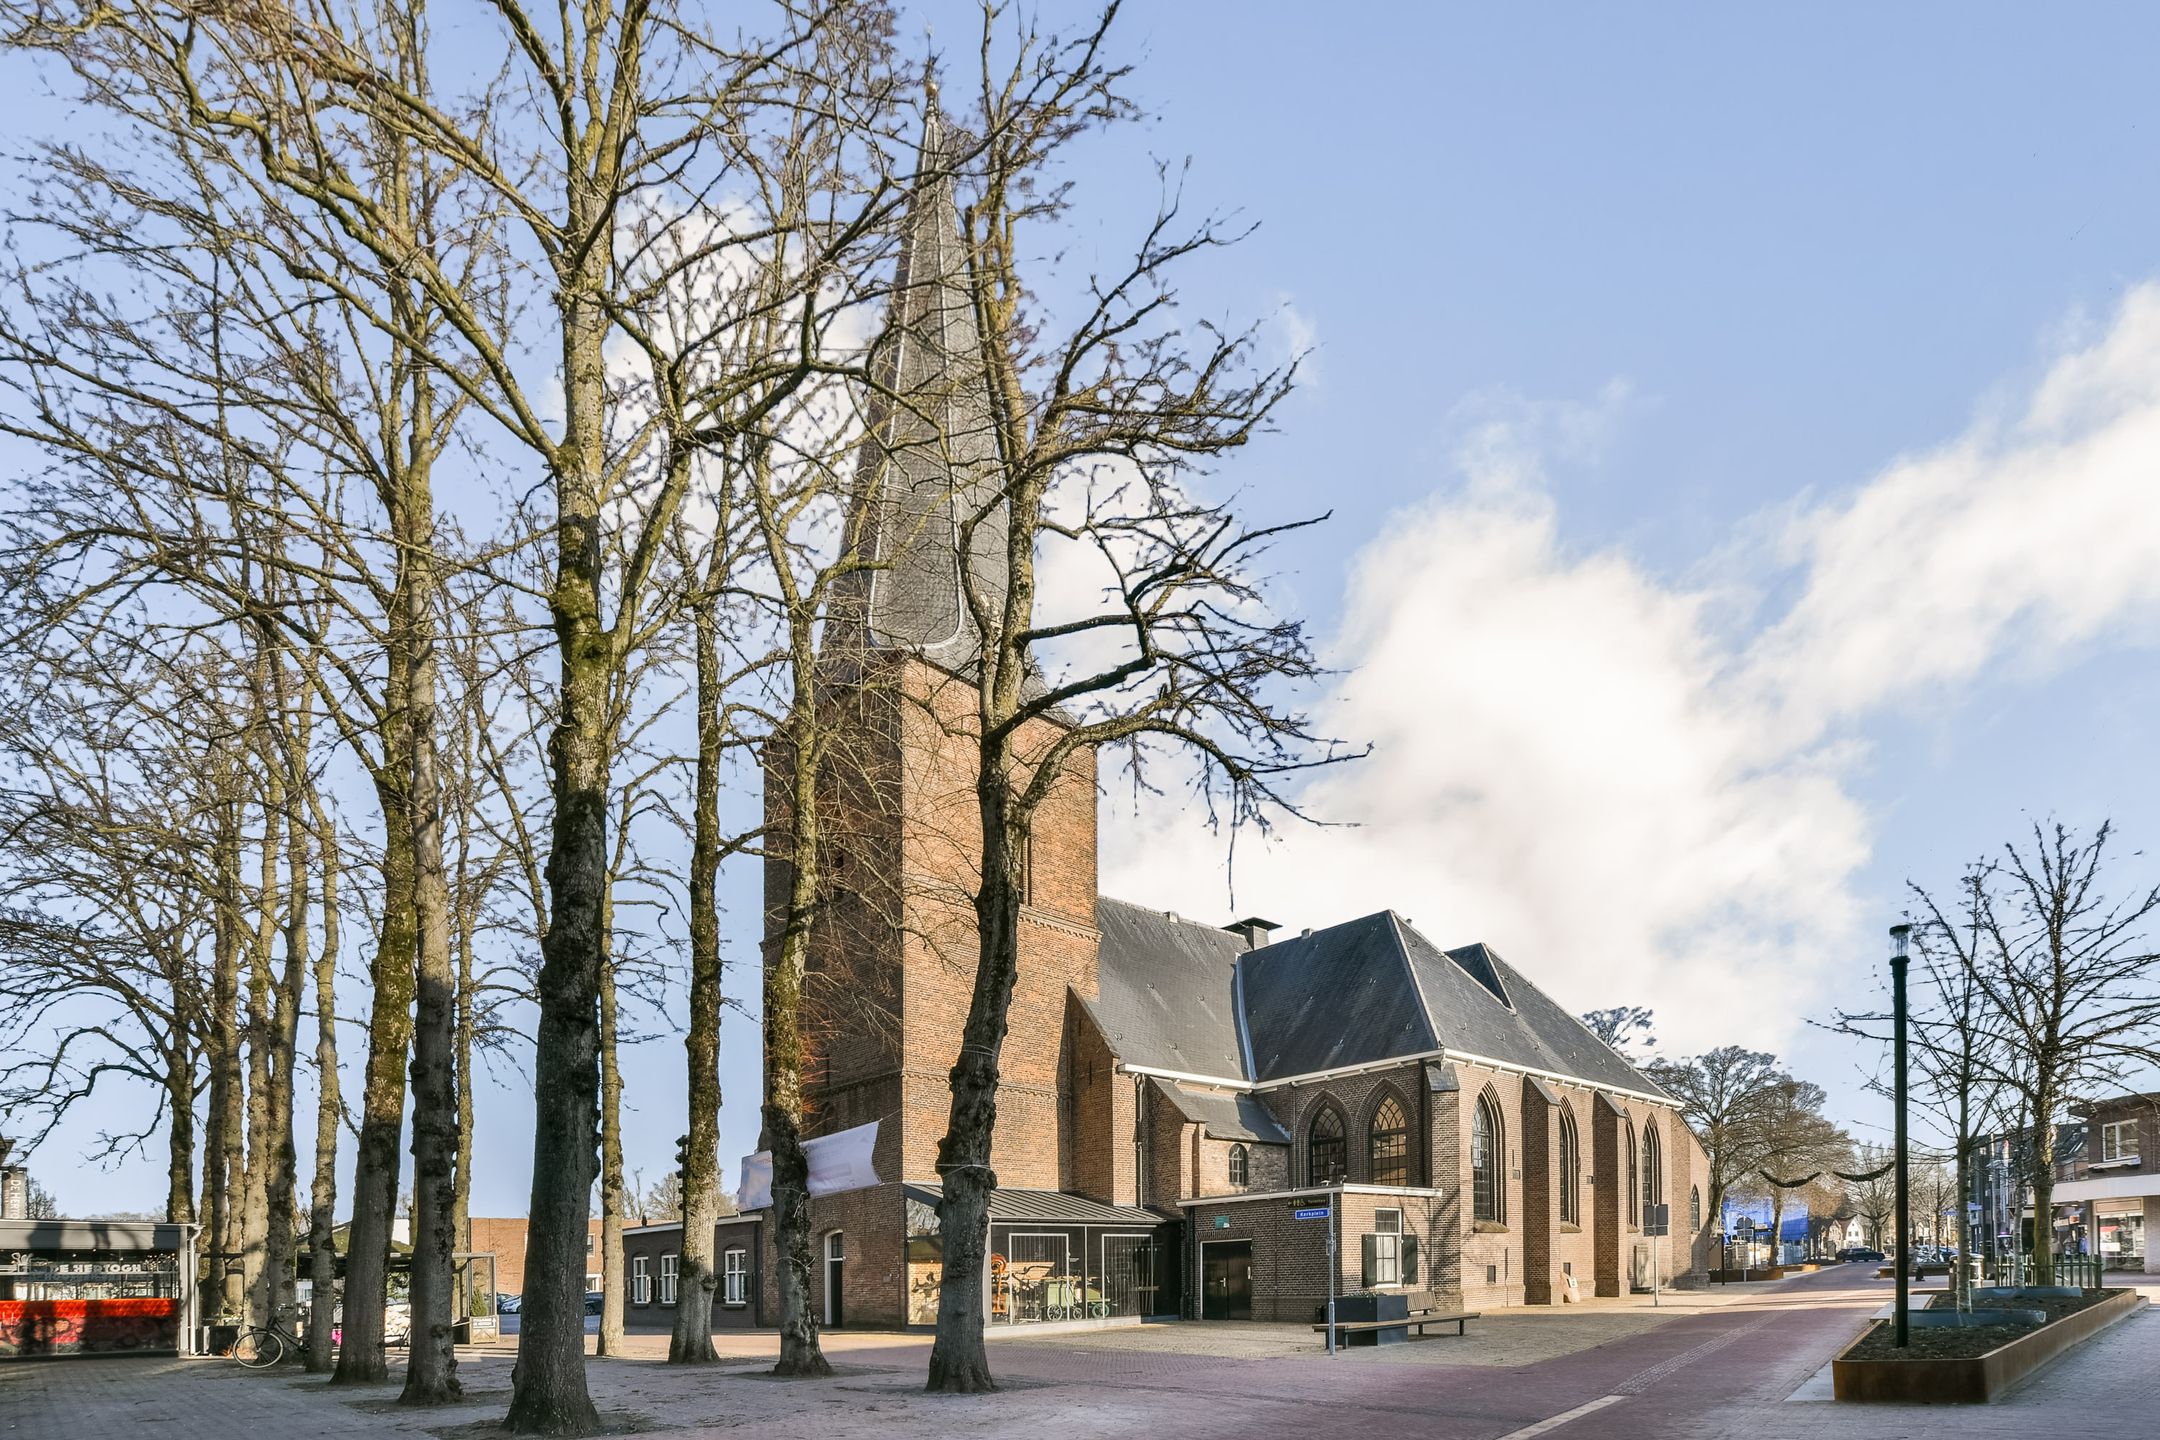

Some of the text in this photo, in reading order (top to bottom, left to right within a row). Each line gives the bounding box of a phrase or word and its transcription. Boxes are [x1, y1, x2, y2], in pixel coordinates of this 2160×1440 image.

[10, 1179, 21, 1219] DE HERTO
[73, 1264, 141, 1273] HERTOGH
